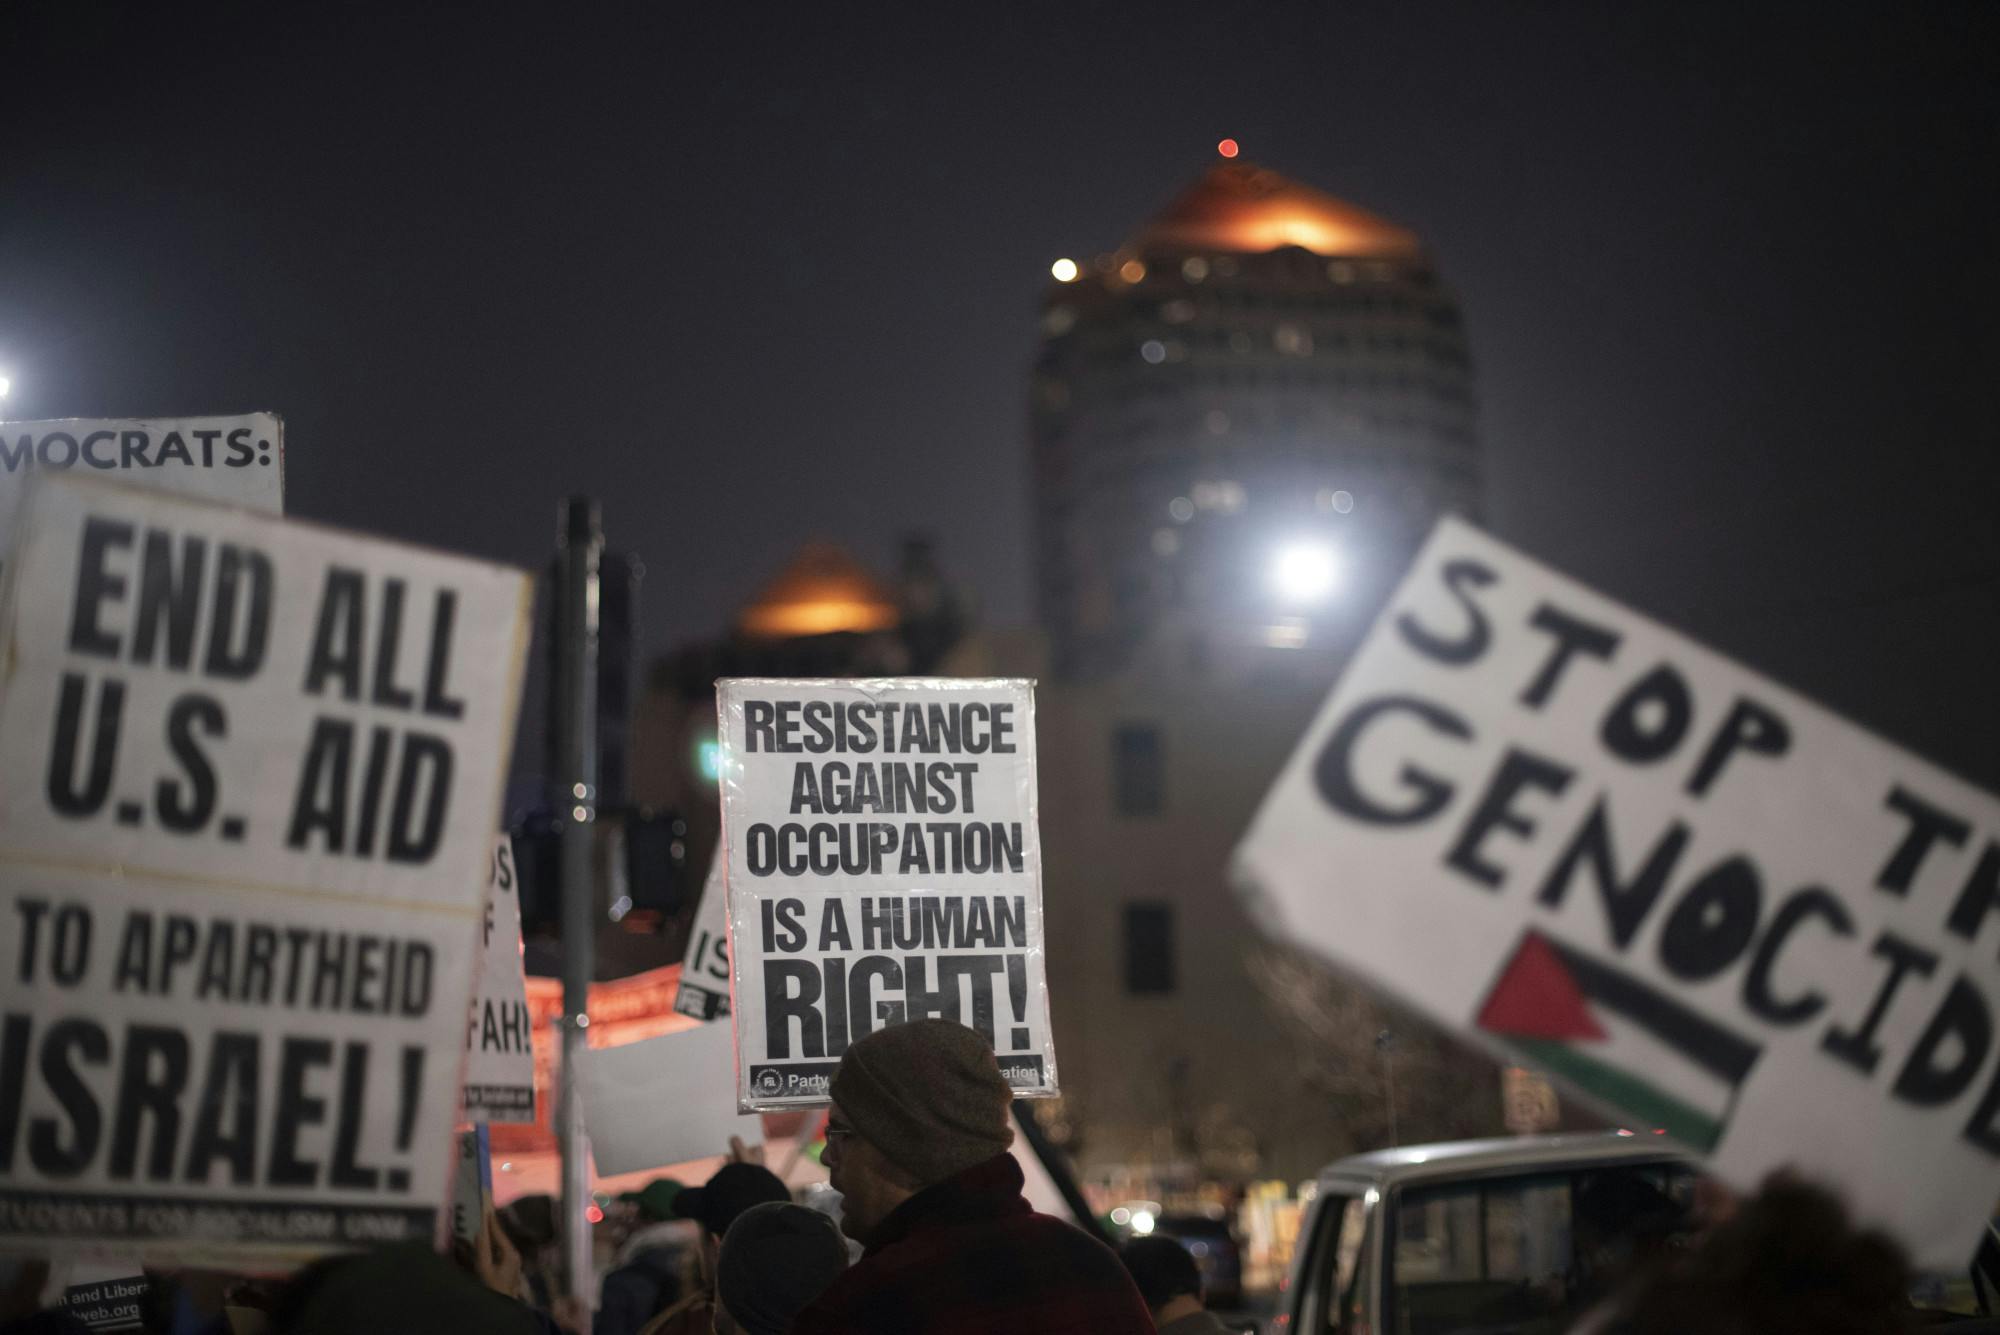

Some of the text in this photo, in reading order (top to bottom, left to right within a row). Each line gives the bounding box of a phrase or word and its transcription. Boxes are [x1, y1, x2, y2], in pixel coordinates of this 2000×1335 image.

[68, 513, 466, 720] END ALL
[1394, 556, 1793, 800] STOP
[46, 670, 453, 866] U.S. AID
[744, 700, 1017, 754] RESISTANCE
[789, 761, 979, 814] AGAINST
[746, 821, 1024, 877] OCCUPATION
[17, 897, 93, 987] TO
[115, 908, 435, 1018] APARTHEID
[761, 895, 1027, 953] IS A HUMAN
[763, 953, 1031, 1060] RIGHT!
[0, 1010, 425, 1192] ISRAEL!
[788, 1074, 829, 1089] Party
[72, 1289, 100, 1304] and
